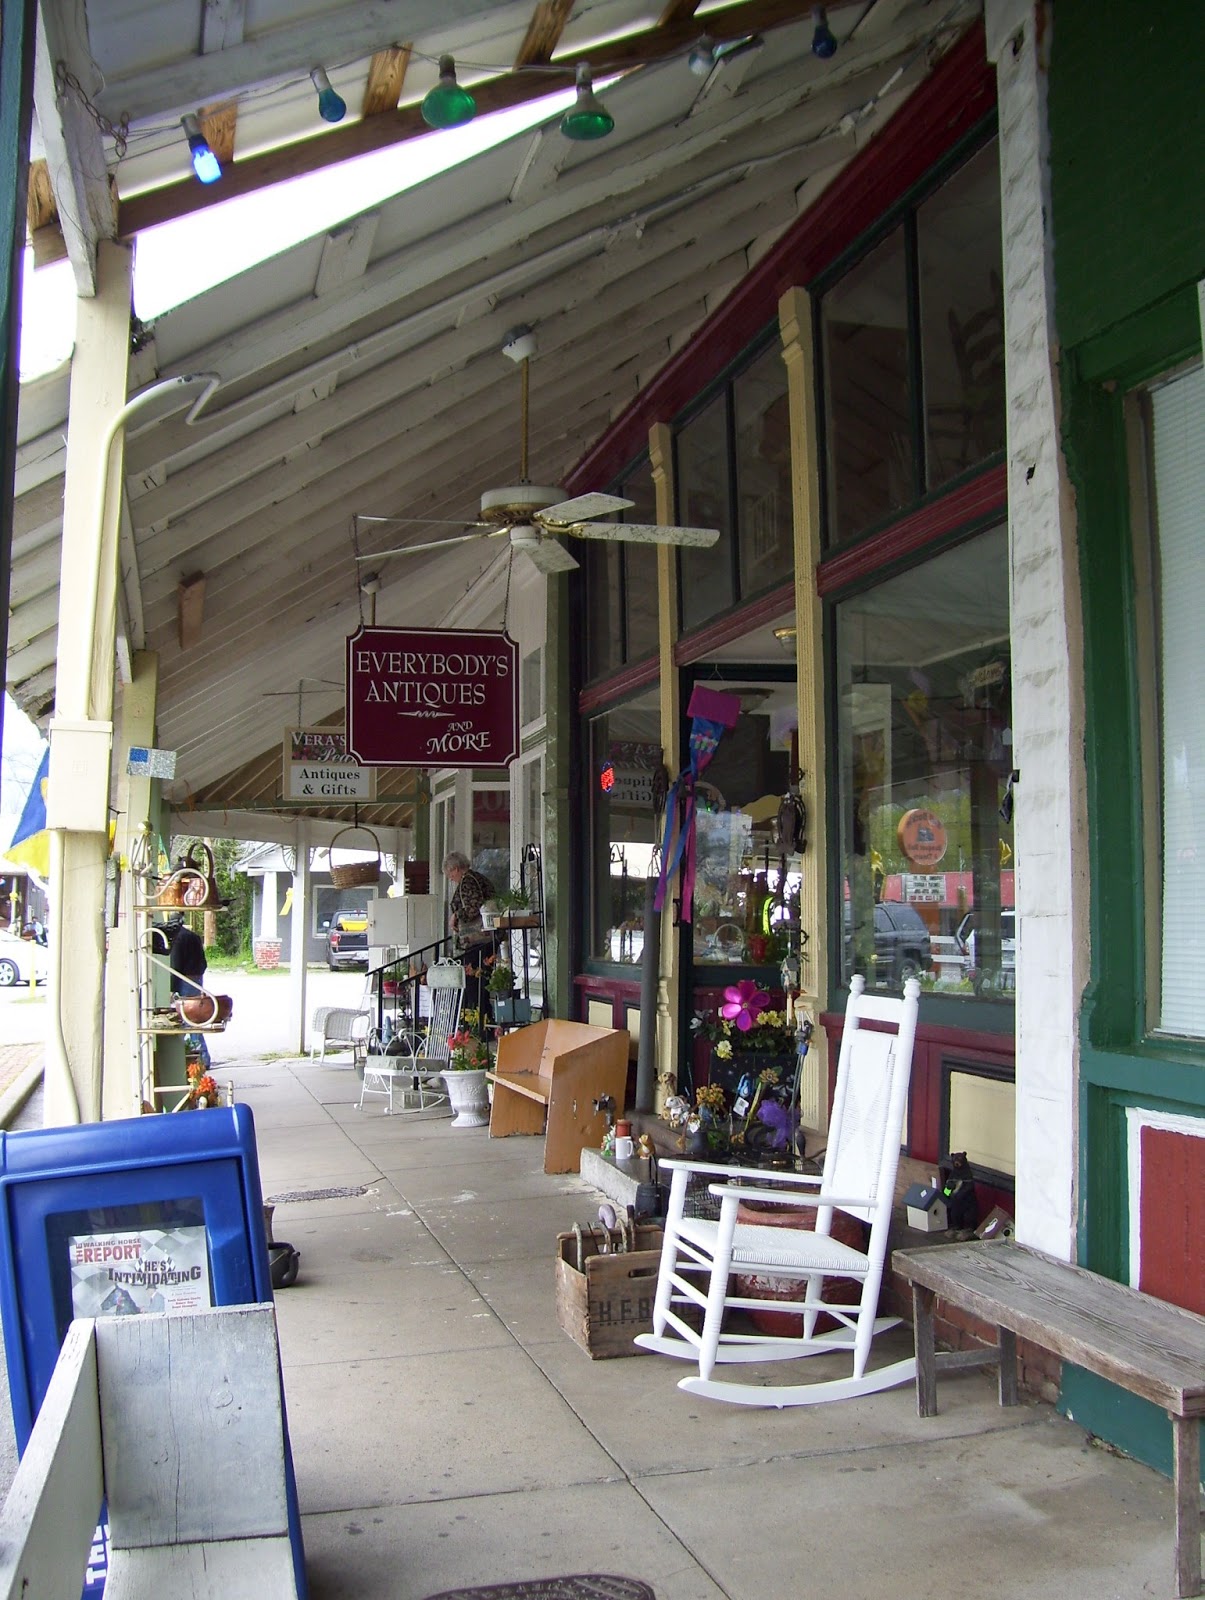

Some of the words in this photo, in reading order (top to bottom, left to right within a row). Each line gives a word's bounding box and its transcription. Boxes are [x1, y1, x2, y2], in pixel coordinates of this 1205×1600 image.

[356, 651, 509, 677] EVERYBODY'S
[365, 680, 486, 708] ANTIQUES
[447, 721, 473, 733] AND
[291, 731, 346, 746] VERA'S
[426, 732, 491, 755] MORE
[300, 768, 360, 781] Antiques
[303, 783, 314, 795] &
[321, 783, 357, 795] Gifts
[83, 1244, 142, 1263] REPORT
[144, 1260, 167, 1272] HE'S
[108, 1266, 202, 1286] INTIMIDATING
